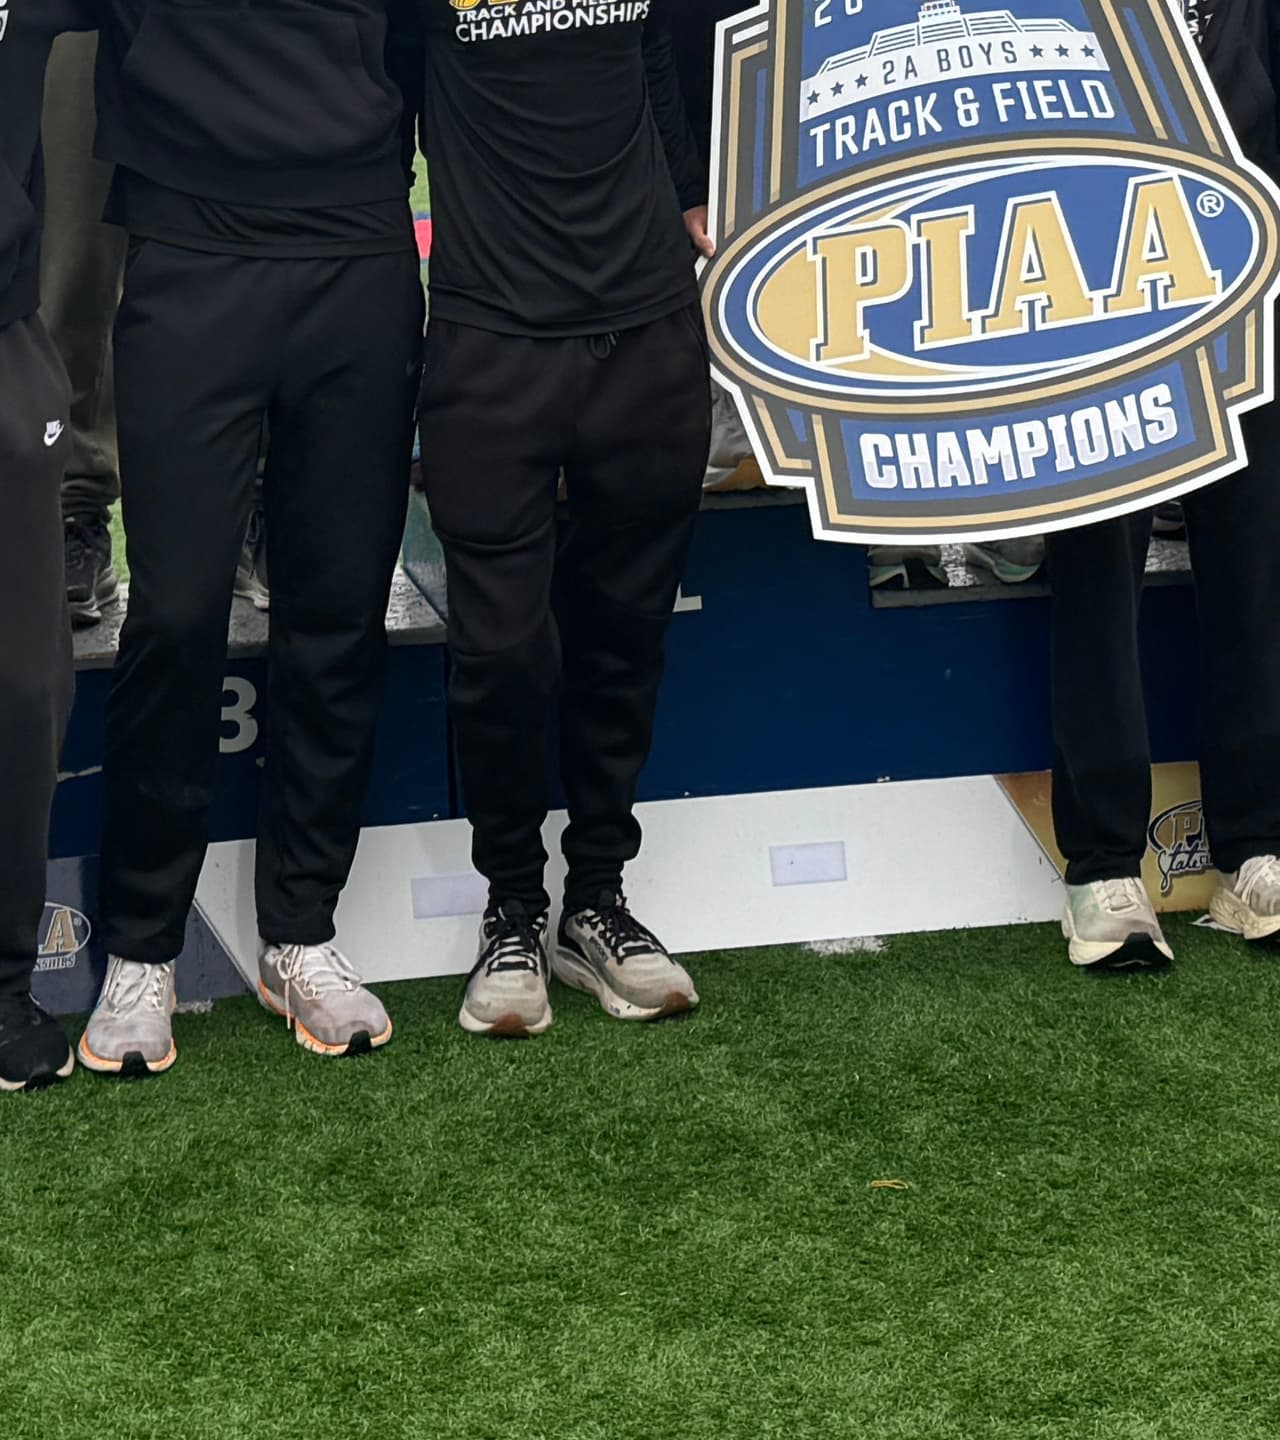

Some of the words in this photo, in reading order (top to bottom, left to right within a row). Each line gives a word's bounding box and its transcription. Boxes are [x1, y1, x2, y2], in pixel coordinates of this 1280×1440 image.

[455, 0, 651, 43] CHAMPIONSHIPS
[456, 5, 517, 24] TRACK
[882, 54, 918, 85] 2A
[938, 39, 1018, 74] BOYS
[809, 90, 939, 168] TRACK
[954, 87, 981, 127] &
[992, 79, 1115, 122] FIELD
[807, 168, 1222, 363] PIAA
[859, 382, 1179, 490] CHAMPIONS
[220, 676, 258, 753] 3
